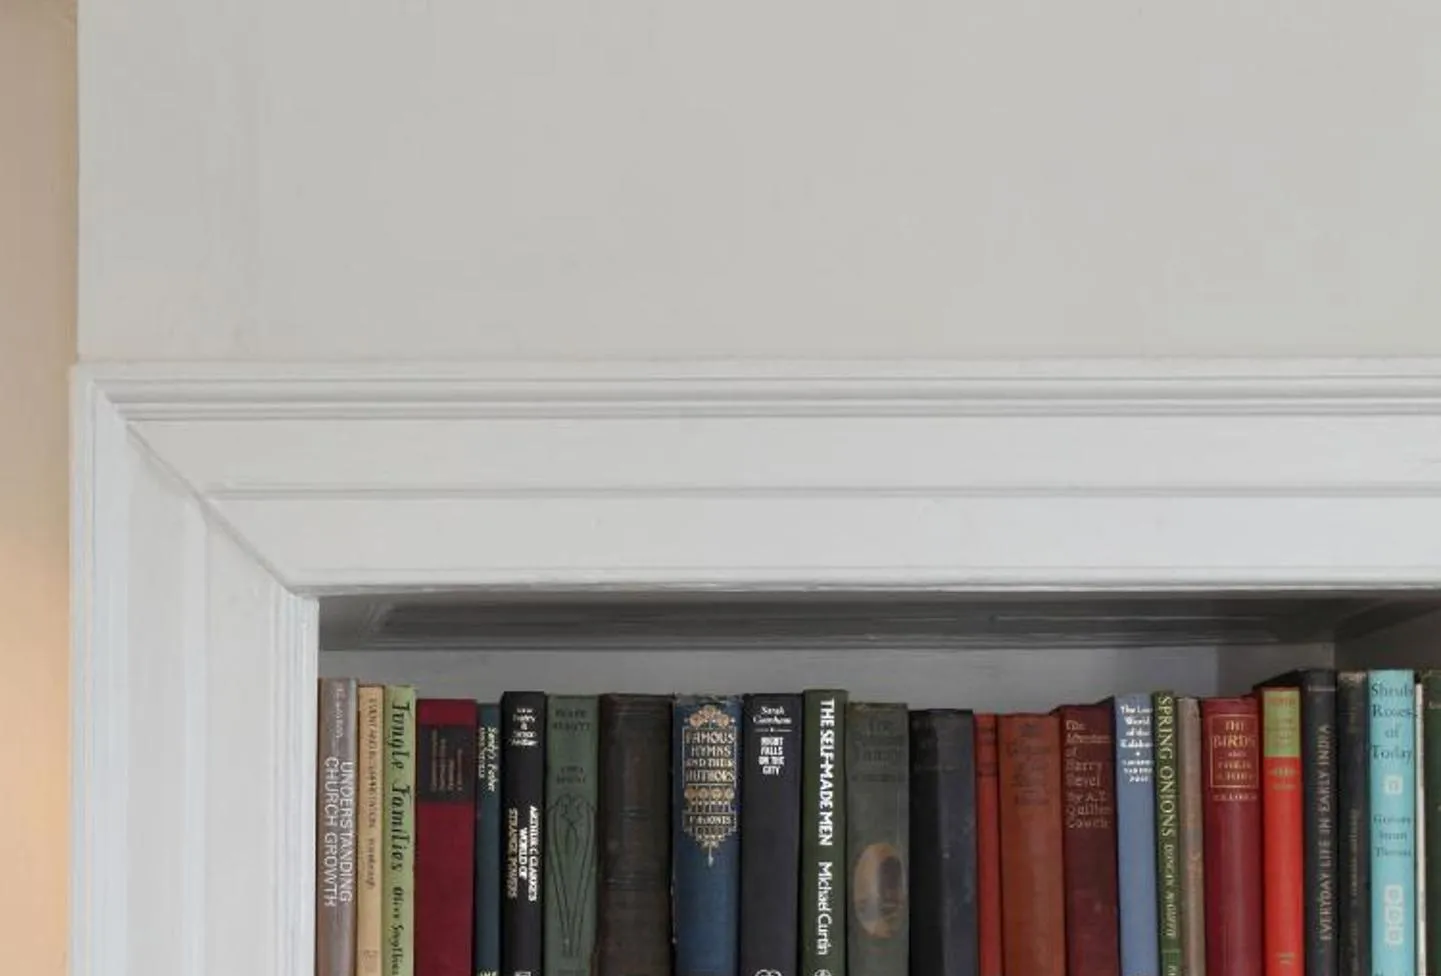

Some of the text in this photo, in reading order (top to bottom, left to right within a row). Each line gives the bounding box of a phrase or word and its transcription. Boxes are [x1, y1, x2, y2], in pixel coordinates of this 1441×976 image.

[388, 702, 410, 771] Jungle
[686, 731, 734, 744] FAMOUS
[689, 746, 732, 757] HYMNS
[1158, 696, 1177, 836] SPRING ONIONS
[1372, 744, 1412, 765] Today
[324, 757, 340, 827] CHURCH
[686, 770, 734, 782] AUTHORS
[820, 699, 835, 846] THE SELF-MADE MEN
[340, 762, 354, 902] UNDERSTANDING
[391, 781, 411, 872] Families
[508, 808, 518, 857] STRANGE
[519, 827, 528, 880] WORLD OF
[1317, 724, 1333, 941] EVERYDAY LIFE IN EARLY INDIA
[323, 832, 339, 906] GROWTH
[817, 862, 833, 955] Michael Curtin
